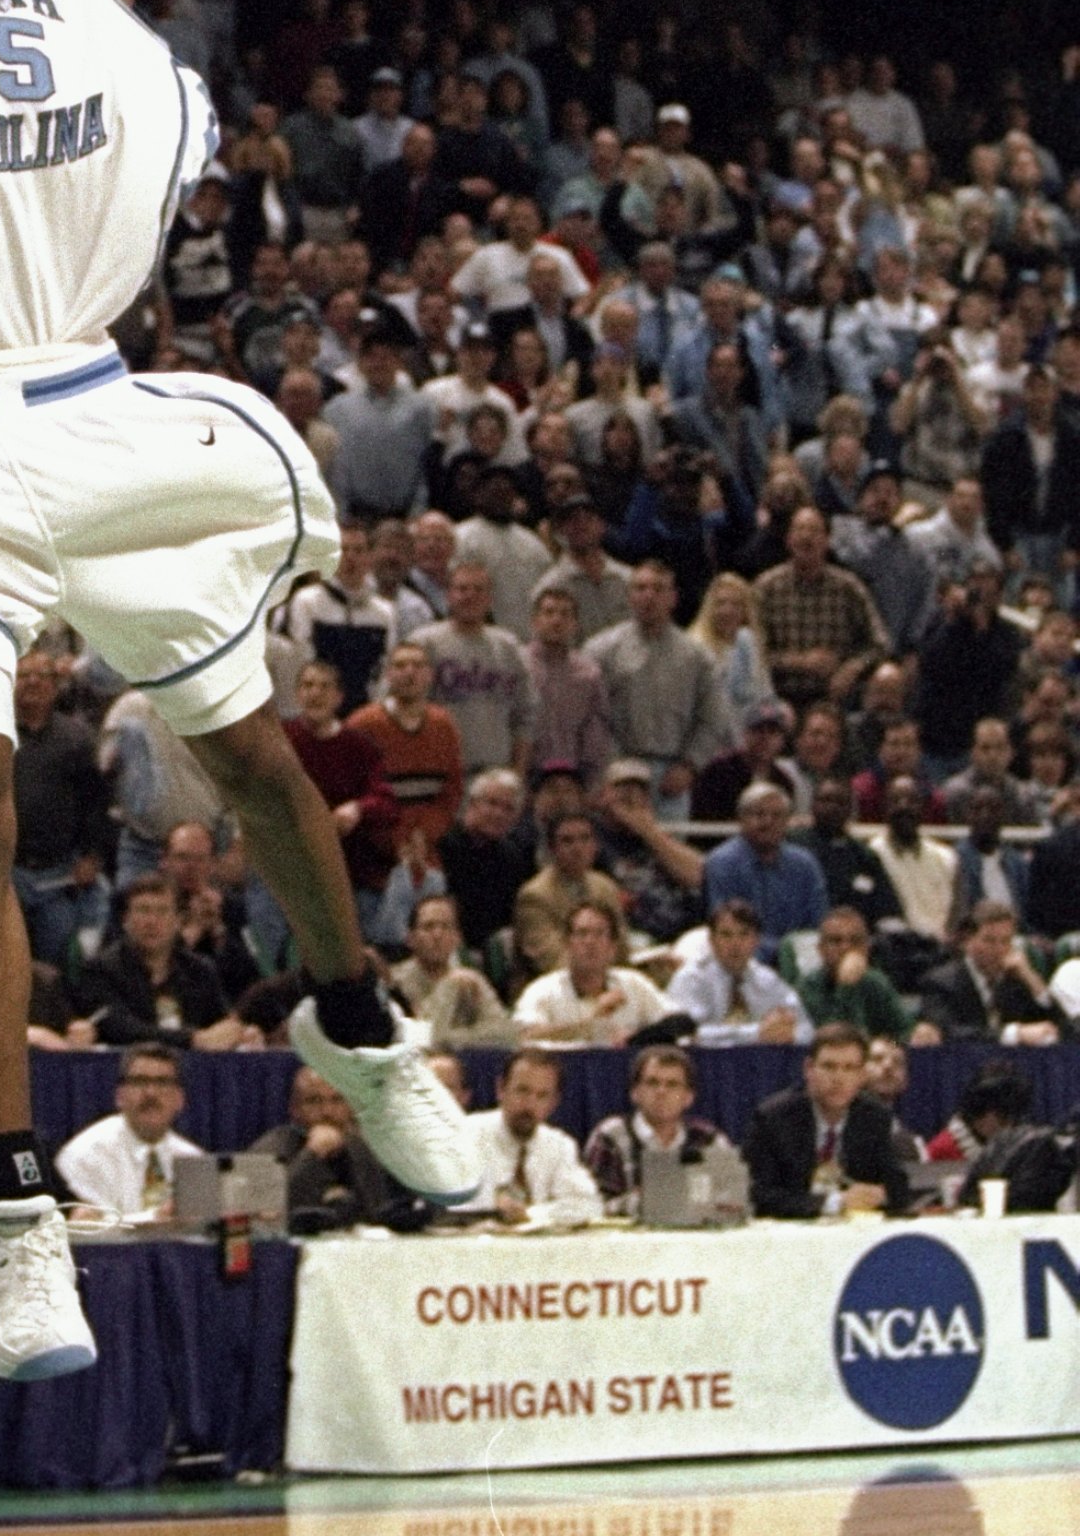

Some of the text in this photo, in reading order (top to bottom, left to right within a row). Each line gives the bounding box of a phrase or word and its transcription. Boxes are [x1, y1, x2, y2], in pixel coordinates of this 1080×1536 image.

[416, 1276, 708, 1326] CONNECTICUT
[839, 1303, 980, 1362] NCAA
[402, 1370, 735, 1424] MICHIGAN STATE
